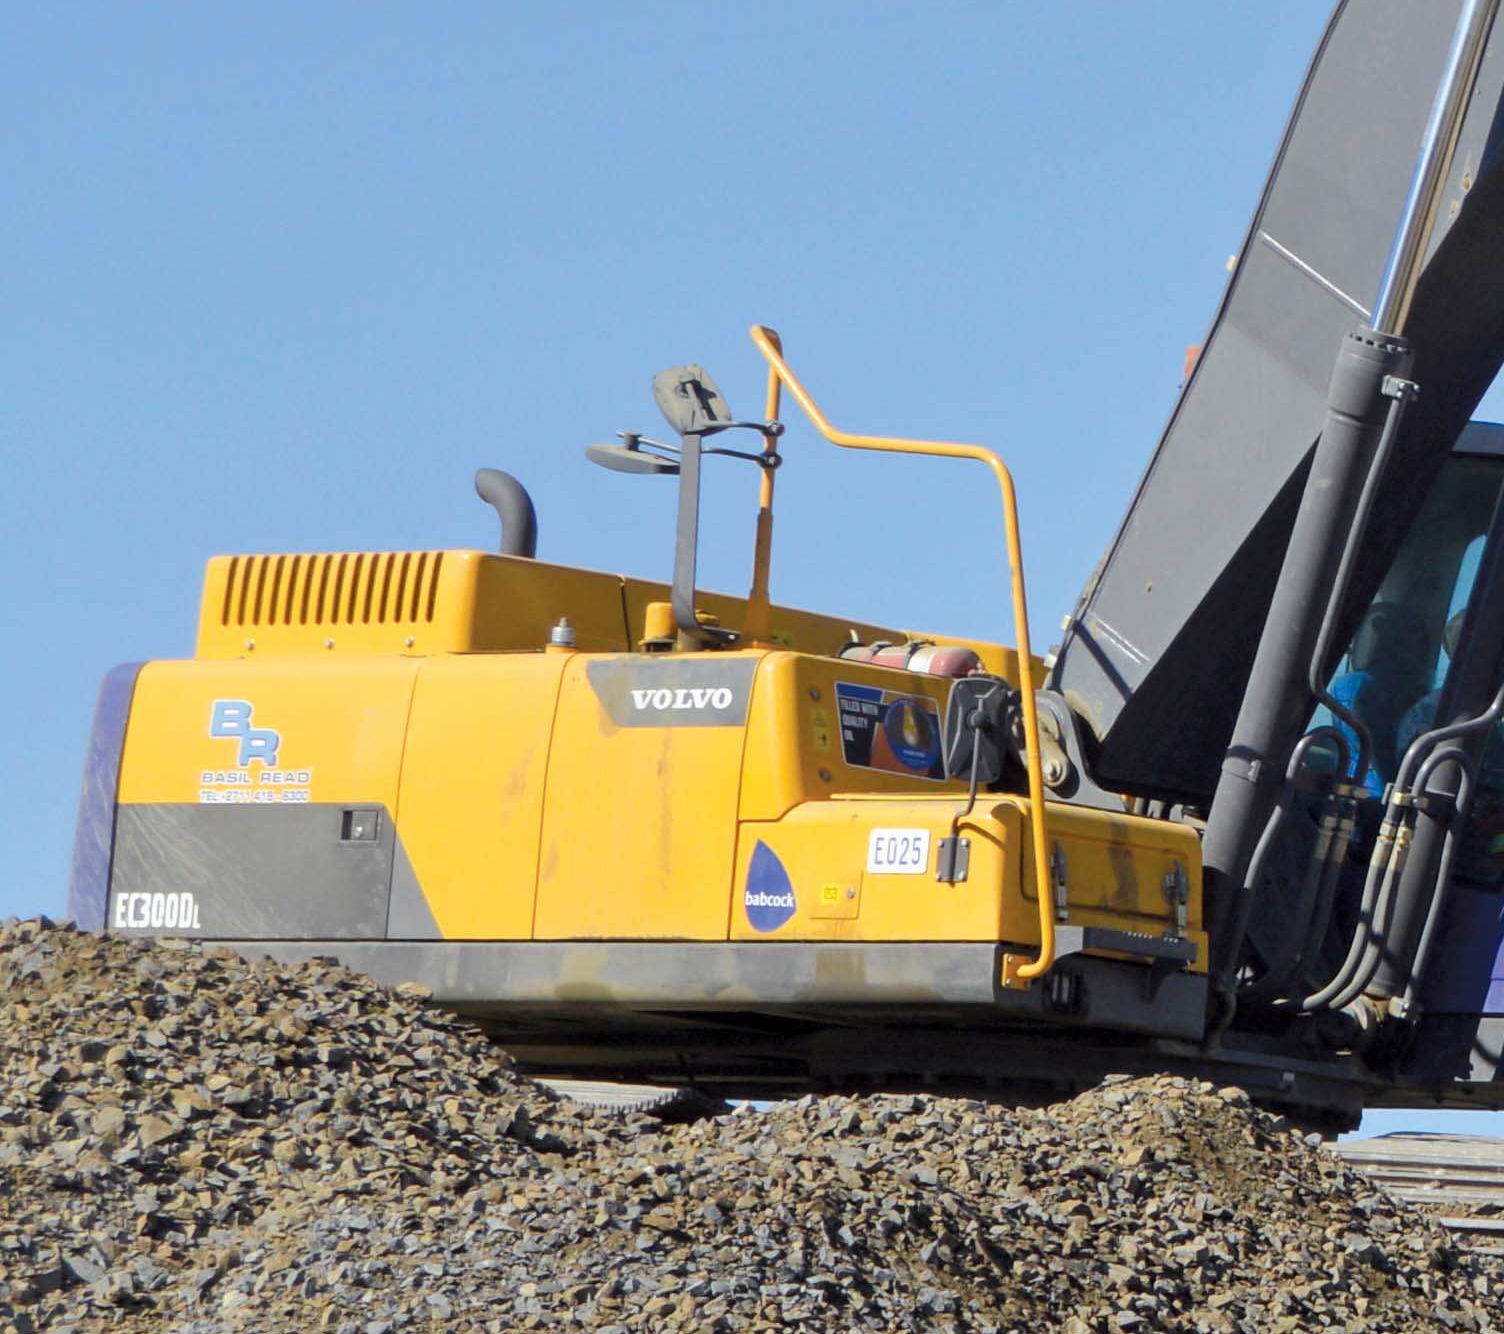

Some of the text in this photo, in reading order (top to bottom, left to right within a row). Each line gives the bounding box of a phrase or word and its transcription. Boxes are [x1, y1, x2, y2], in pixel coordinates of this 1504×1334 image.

[630, 687, 733, 710] VOLVO
[201, 771, 310, 784] BASIL READ
[874, 836, 922, 865] E025
[744, 890, 794, 908] babcock
